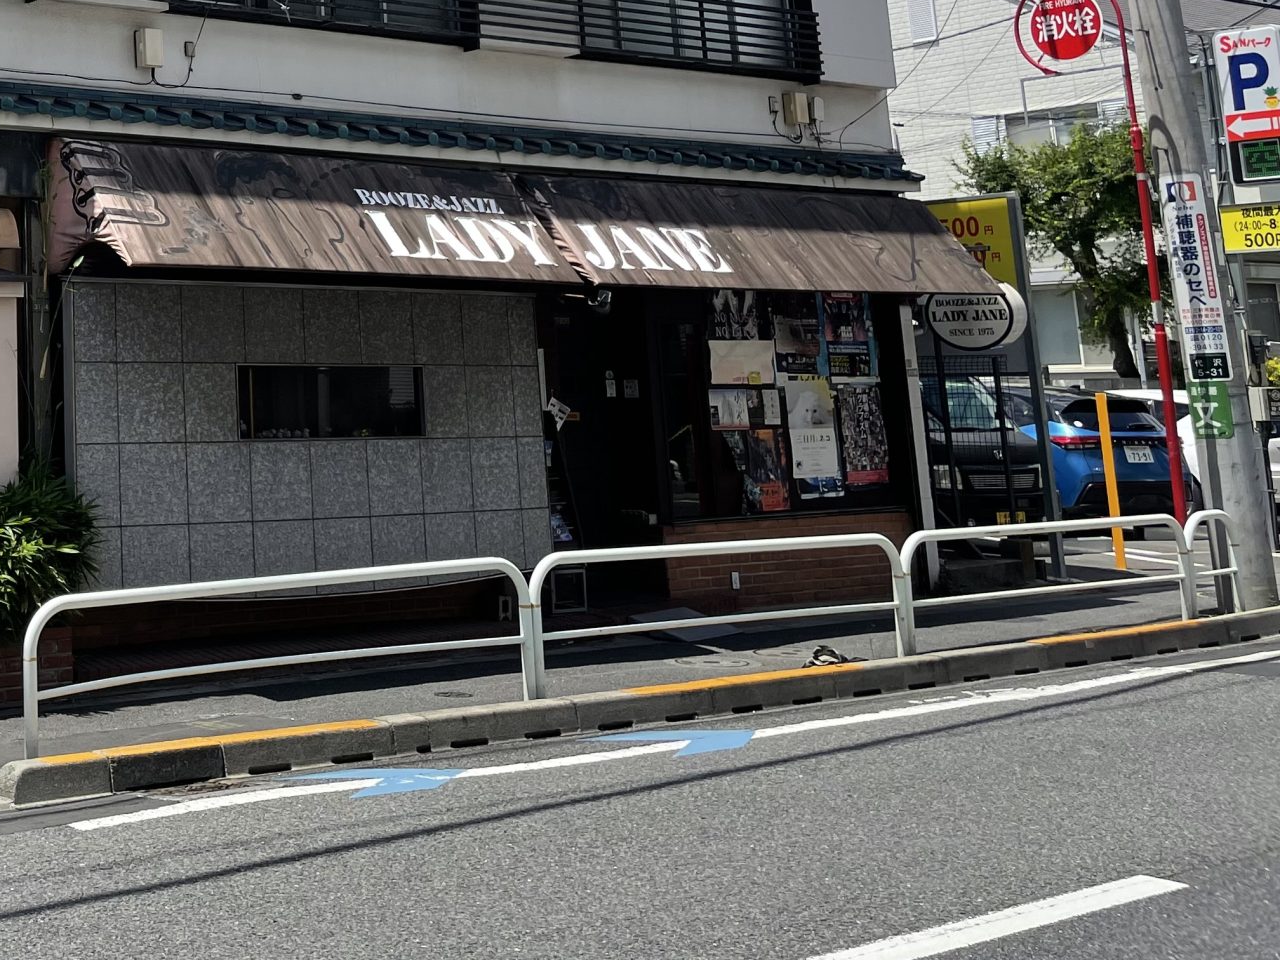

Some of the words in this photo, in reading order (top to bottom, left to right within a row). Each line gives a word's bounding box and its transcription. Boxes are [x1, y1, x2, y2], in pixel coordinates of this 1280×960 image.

[1038, 0, 1054, 11] FIRE
[1035, 7, 1097, 43] 消火栓
[1227, 52, 1270, 111] P
[353, 188, 504, 215] BOOZE&JAZZ
[364, 210, 559, 267] LADY
[575, 223, 734, 273] JANE
[935, 297, 1000, 308] BOOZE&JAZZ
[931, 309, 969, 323] LADY
[972, 308, 1008, 322] JANE
[949, 328, 975, 337] SINCE
[978, 327, 995, 336] 1975
